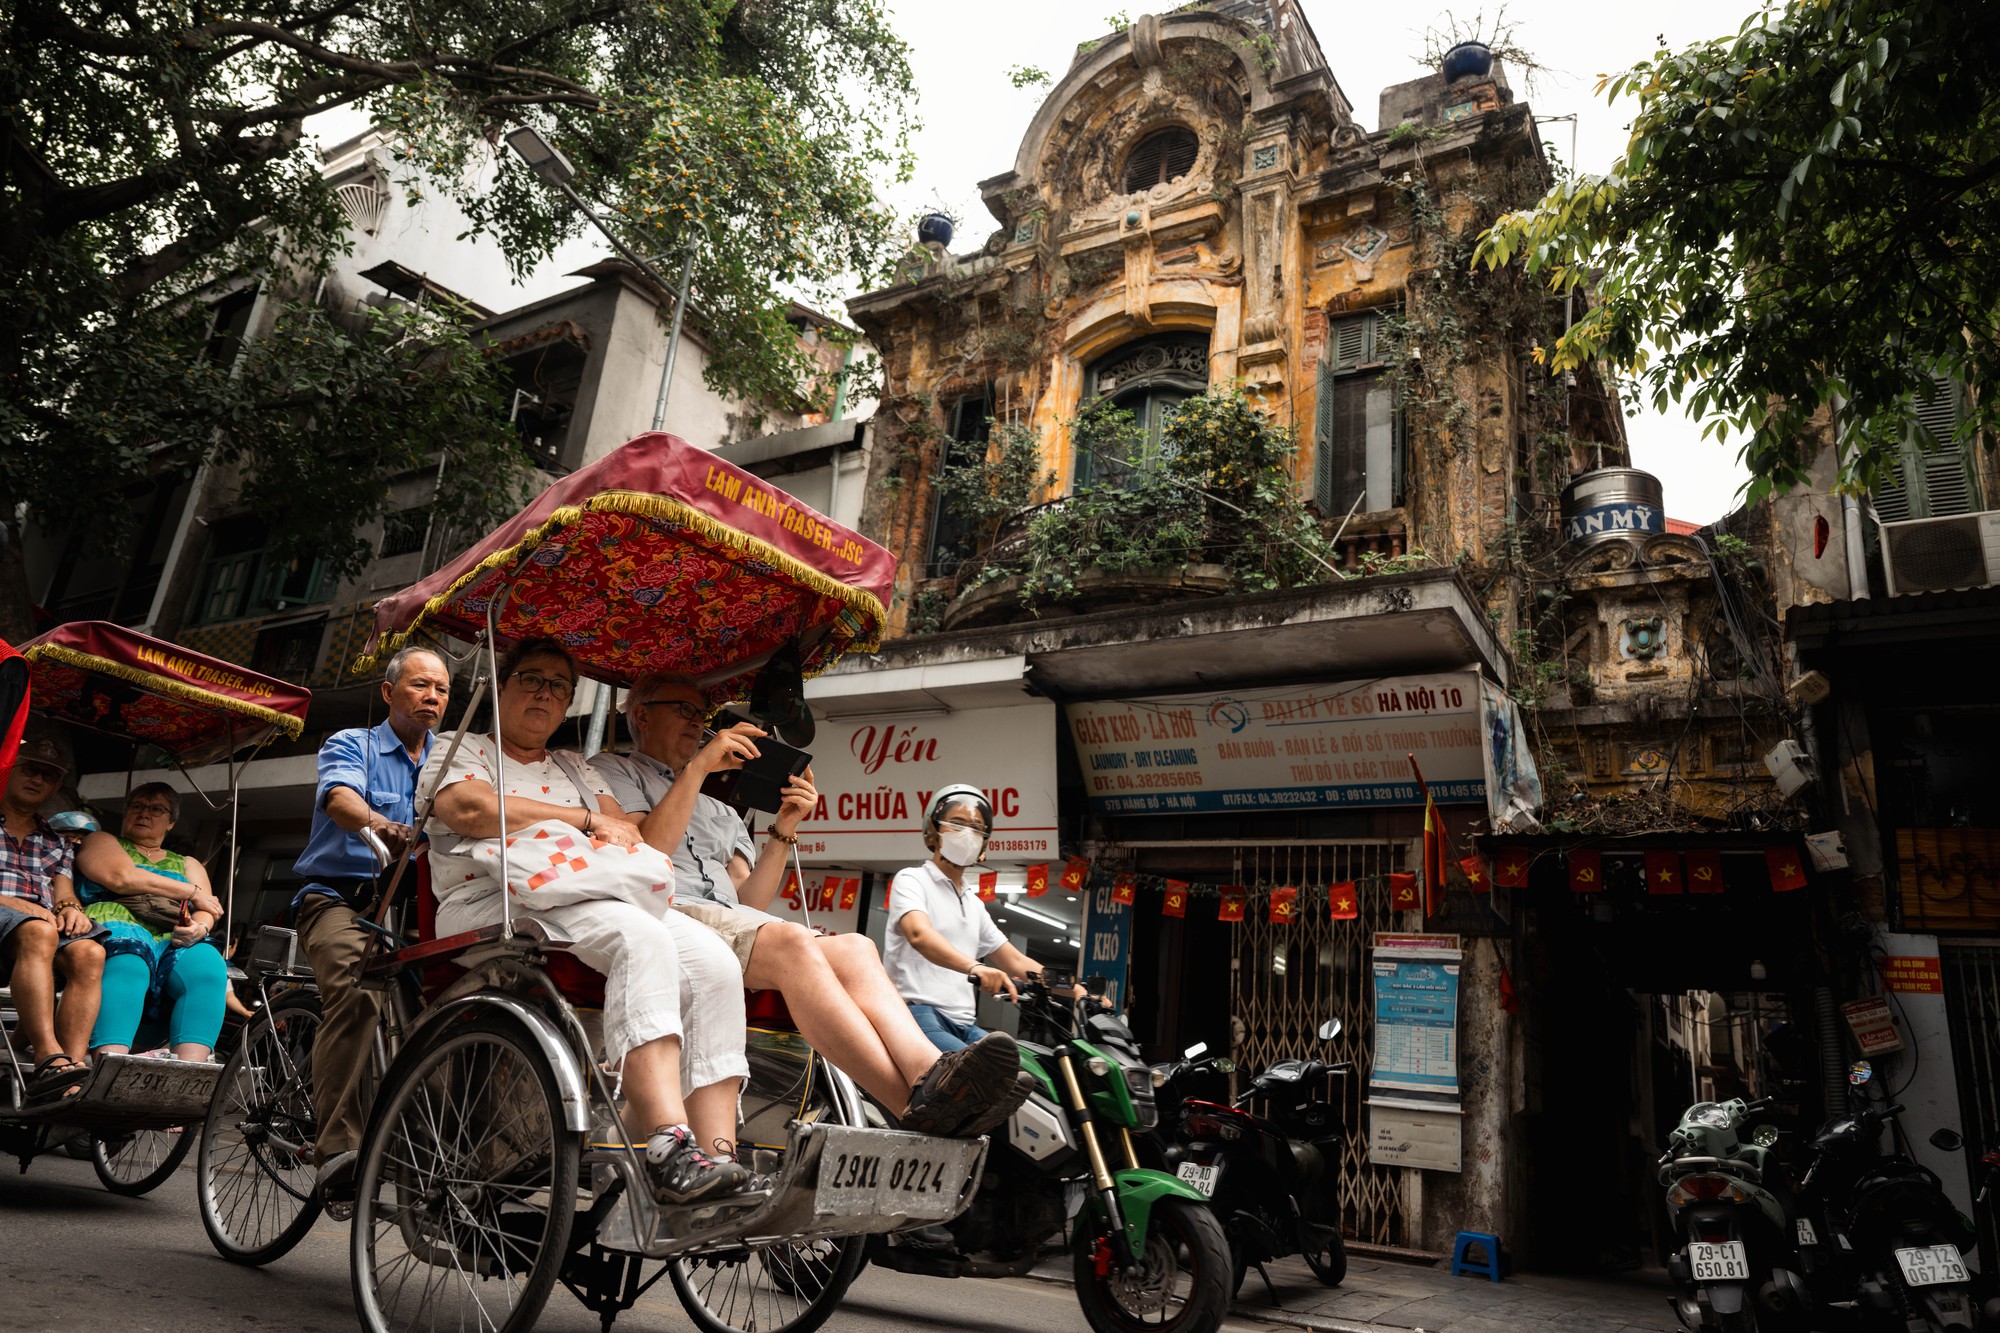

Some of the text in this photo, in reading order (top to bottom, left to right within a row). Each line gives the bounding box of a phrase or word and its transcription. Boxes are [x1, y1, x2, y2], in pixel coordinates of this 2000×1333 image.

[705, 466, 742, 502] LAM
[740, 486, 776, 520] ANH
[1611, 505, 1652, 530] MỸ
[137, 645, 164, 666] LAM
[168, 656, 195, 677] ANH
[1262, 702, 1294, 723] ĐẠI
[1296, 694, 1318, 718] LÝ
[1352, 686, 1374, 714] SỐ
[1378, 688, 1402, 712] HÀ
[1405, 686, 1436, 714] NỘI
[1441, 688, 1462, 708] 10
[1076, 710, 1109, 749] GIẶT
[1109, 706, 1140, 742] KHÔ
[1147, 704, 1169, 739] LÀ
[1168, 708, 1197, 738] HƠI
[850, 724, 941, 775] Yến
[1218, 740, 1242, 760] BÁN
[1244, 738, 1276, 758] BUÔN
[1285, 736, 1310, 756] BÁN
[1313, 730, 1328, 755] LẺ
[1330, 736, 1340, 754] &
[1342, 728, 1362, 753] ĐỔI
[1365, 728, 1383, 752] SỐ
[1385, 728, 1428, 750] TRÚNG
[1090, 752, 1128, 770] LAUNDRY
[1134, 750, 1152, 768] DRY
[1153, 748, 1198, 766] CLEANING
[1290, 754, 1410, 783] THỦ ĐÔ VÀ CÁC TỈNH
[1117, 772, 1202, 789] 04.38285605
[1347, 788, 1371, 800] 0913
[1374, 788, 1392, 800] 920
[1394, 786, 1413, 798] 610
[1450, 784, 1469, 796] 495
[838, 786, 908, 820] CHỮA
[916, 791, 934, 818] Y
[1122, 798, 1146, 810] HÀNG
[1166, 796, 1180, 808] HÀ
[1180, 794, 1196, 810] NỘI
[988, 840, 1047, 852] 0913863179
[1093, 924, 1119, 960] KHÔ
[832, 1154, 945, 1193] 29XL 0224
[1183, 1166, 1211, 1180] 29-AD
[1697, 1244, 1736, 1260] 29-C1
[1906, 1248, 1952, 1267] 29-T2
[1696, 1261, 1744, 1278] 650.81
[1908, 1263, 1964, 1284] 067.29
